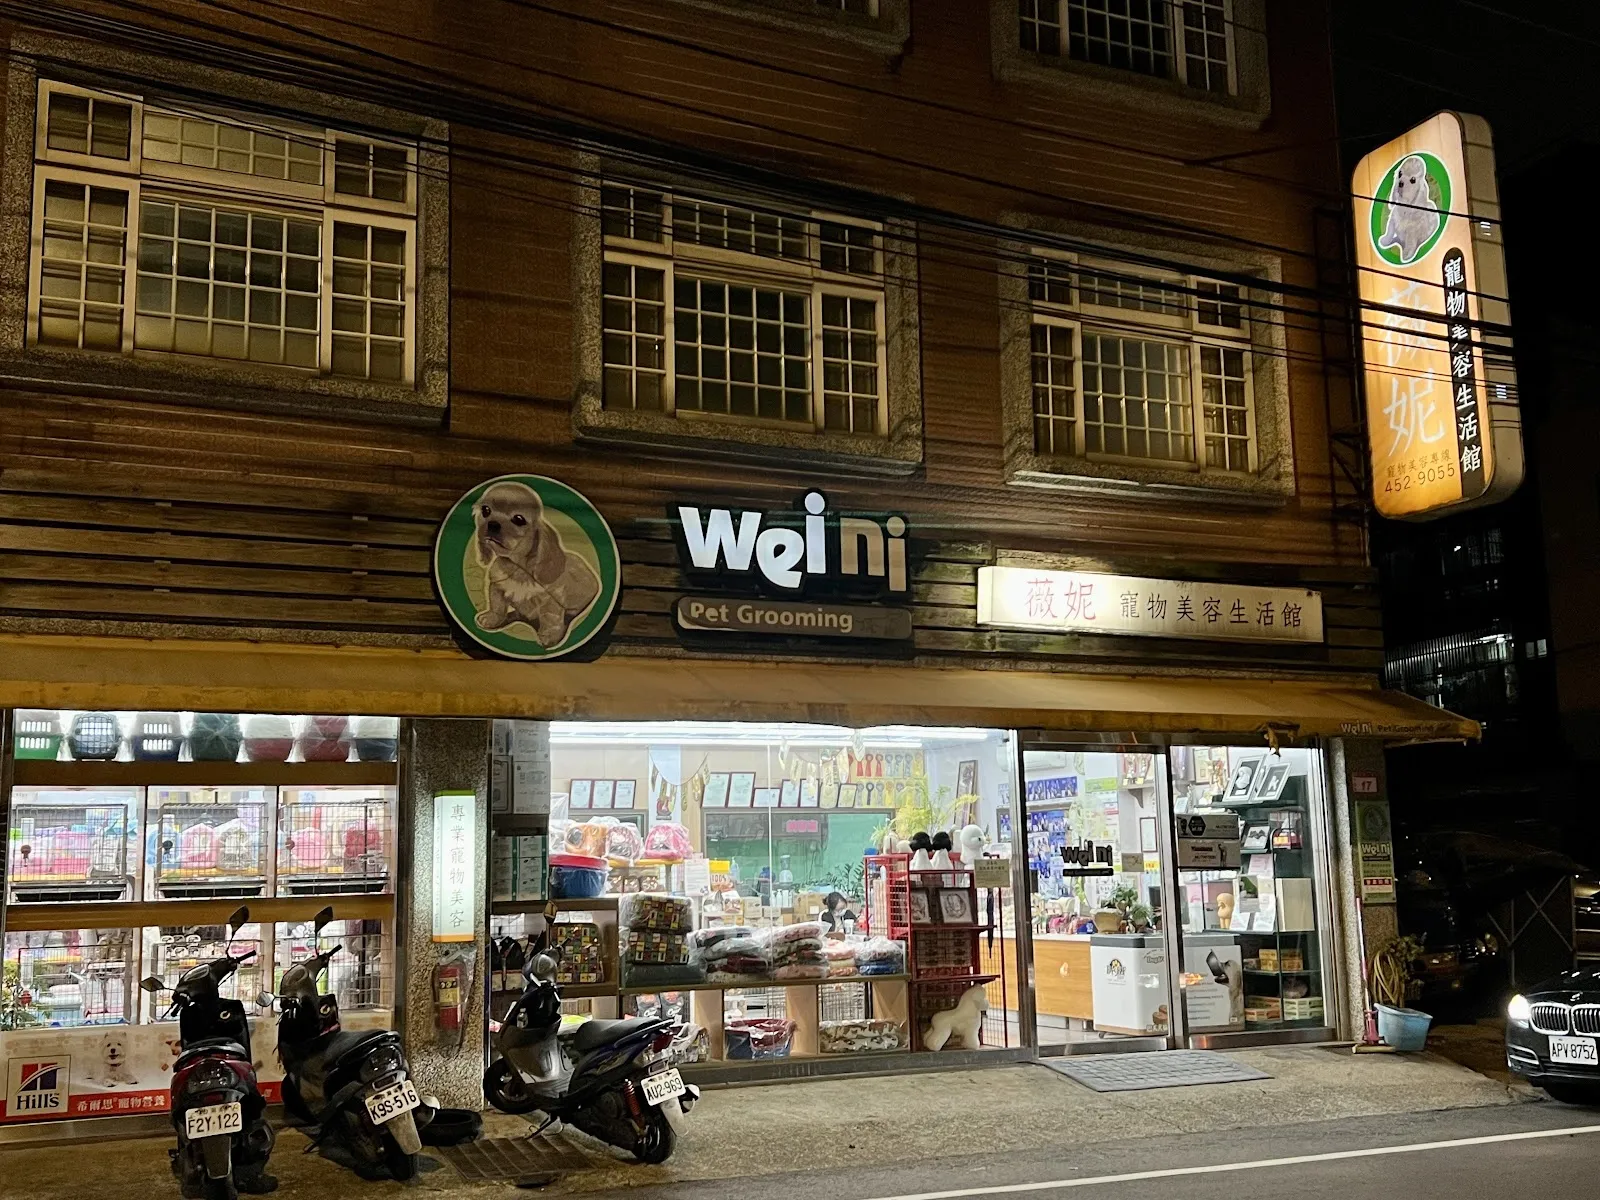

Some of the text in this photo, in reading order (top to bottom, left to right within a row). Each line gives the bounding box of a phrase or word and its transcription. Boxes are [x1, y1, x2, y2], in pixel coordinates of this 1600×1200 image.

[1024, 577, 1098, 621] 薇妮
[1119, 590, 1304, 629] 寵物美容生活館
[690, 602, 853, 633] Pet Grooming
[1361, 780, 1373, 791] 17
[17, 1092, 60, 1111] Hill's
